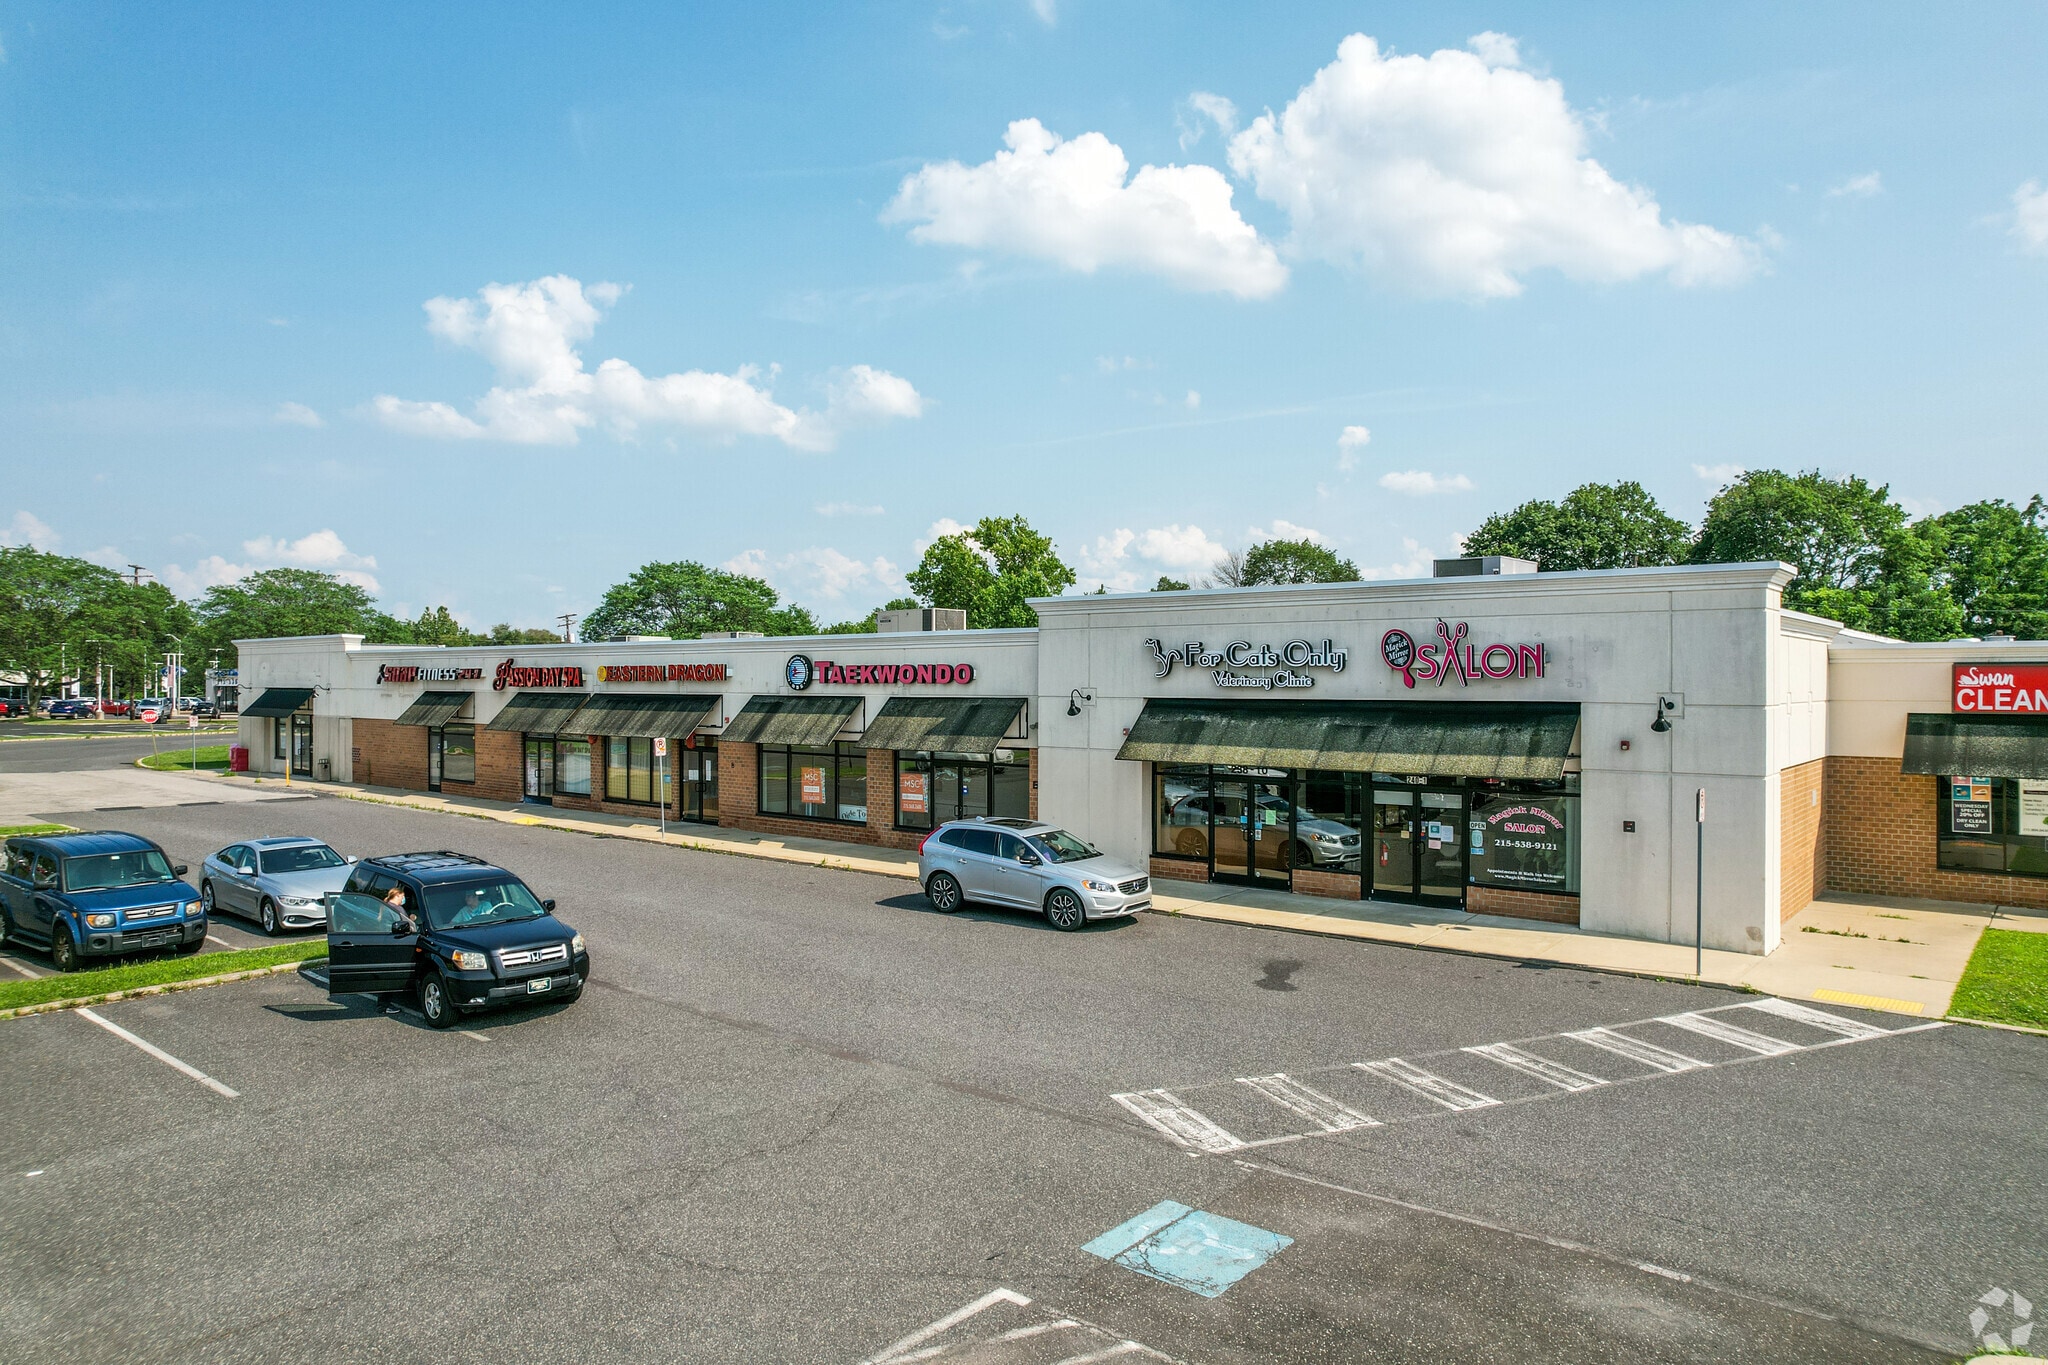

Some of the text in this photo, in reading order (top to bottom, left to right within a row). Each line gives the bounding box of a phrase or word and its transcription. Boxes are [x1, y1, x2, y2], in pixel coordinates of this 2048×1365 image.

[1385, 639, 1408, 653] Magick
[1183, 639, 1346, 673] For Cats Only
[1388, 648, 1409, 661] Mirror
[417, 668, 457, 681] FITNESS
[541, 667, 560, 687] DAY
[561, 666, 582, 688] SPA
[605, 664, 727, 682] EASTERN DRAGON
[814, 661, 973, 684] TAEKWONDO
[1211, 670, 1314, 690] Veterinary Clinic
[1957, 666, 2016, 688] Swan
[804, 773, 818, 781] MSC
[904, 780, 920, 788] MSC
[1488, 806, 1564, 829] Magick Mirror
[1504, 822, 1546, 834] SALON
[1495, 839, 1557, 851] 215-538-9121
